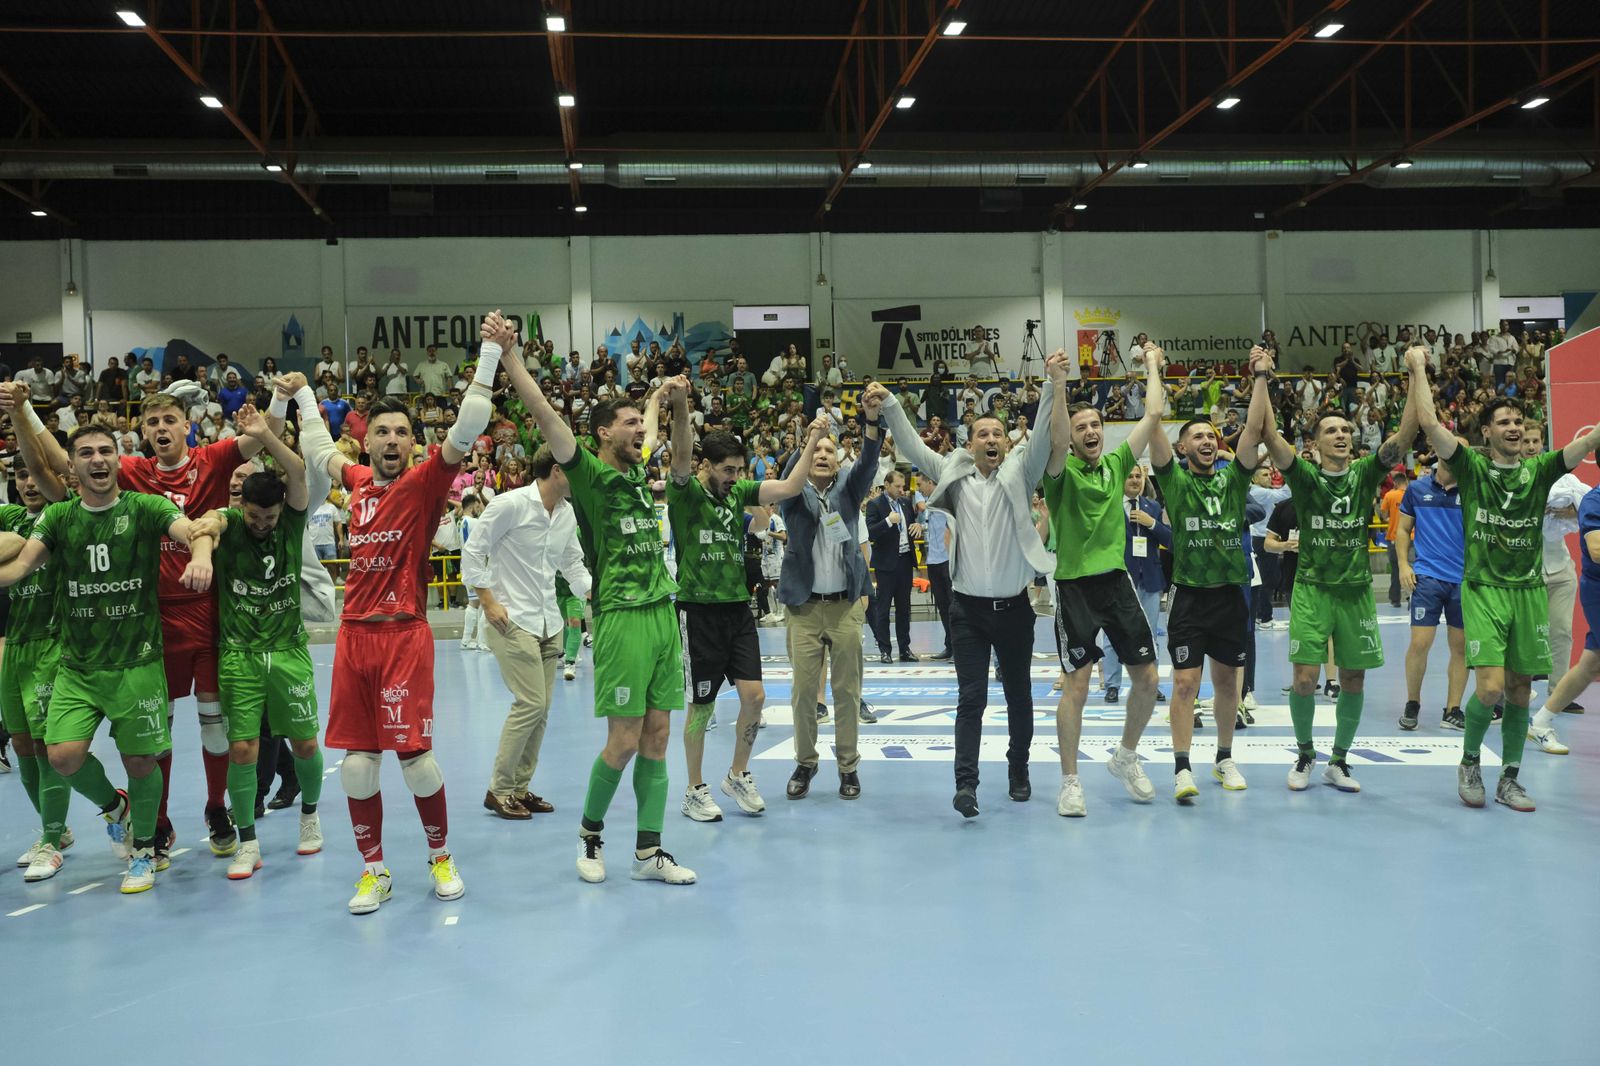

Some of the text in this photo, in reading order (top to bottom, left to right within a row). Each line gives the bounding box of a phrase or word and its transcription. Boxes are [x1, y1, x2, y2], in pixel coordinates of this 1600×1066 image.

[917, 326, 1000, 342] SITIO DÓLMEES
[1205, 496, 1221, 516] 11
[1330, 496, 1351, 514] 21
[86, 543, 110, 573] 18
[263, 555, 275, 580] 2
[79, 578, 142, 595] BESOCCER
